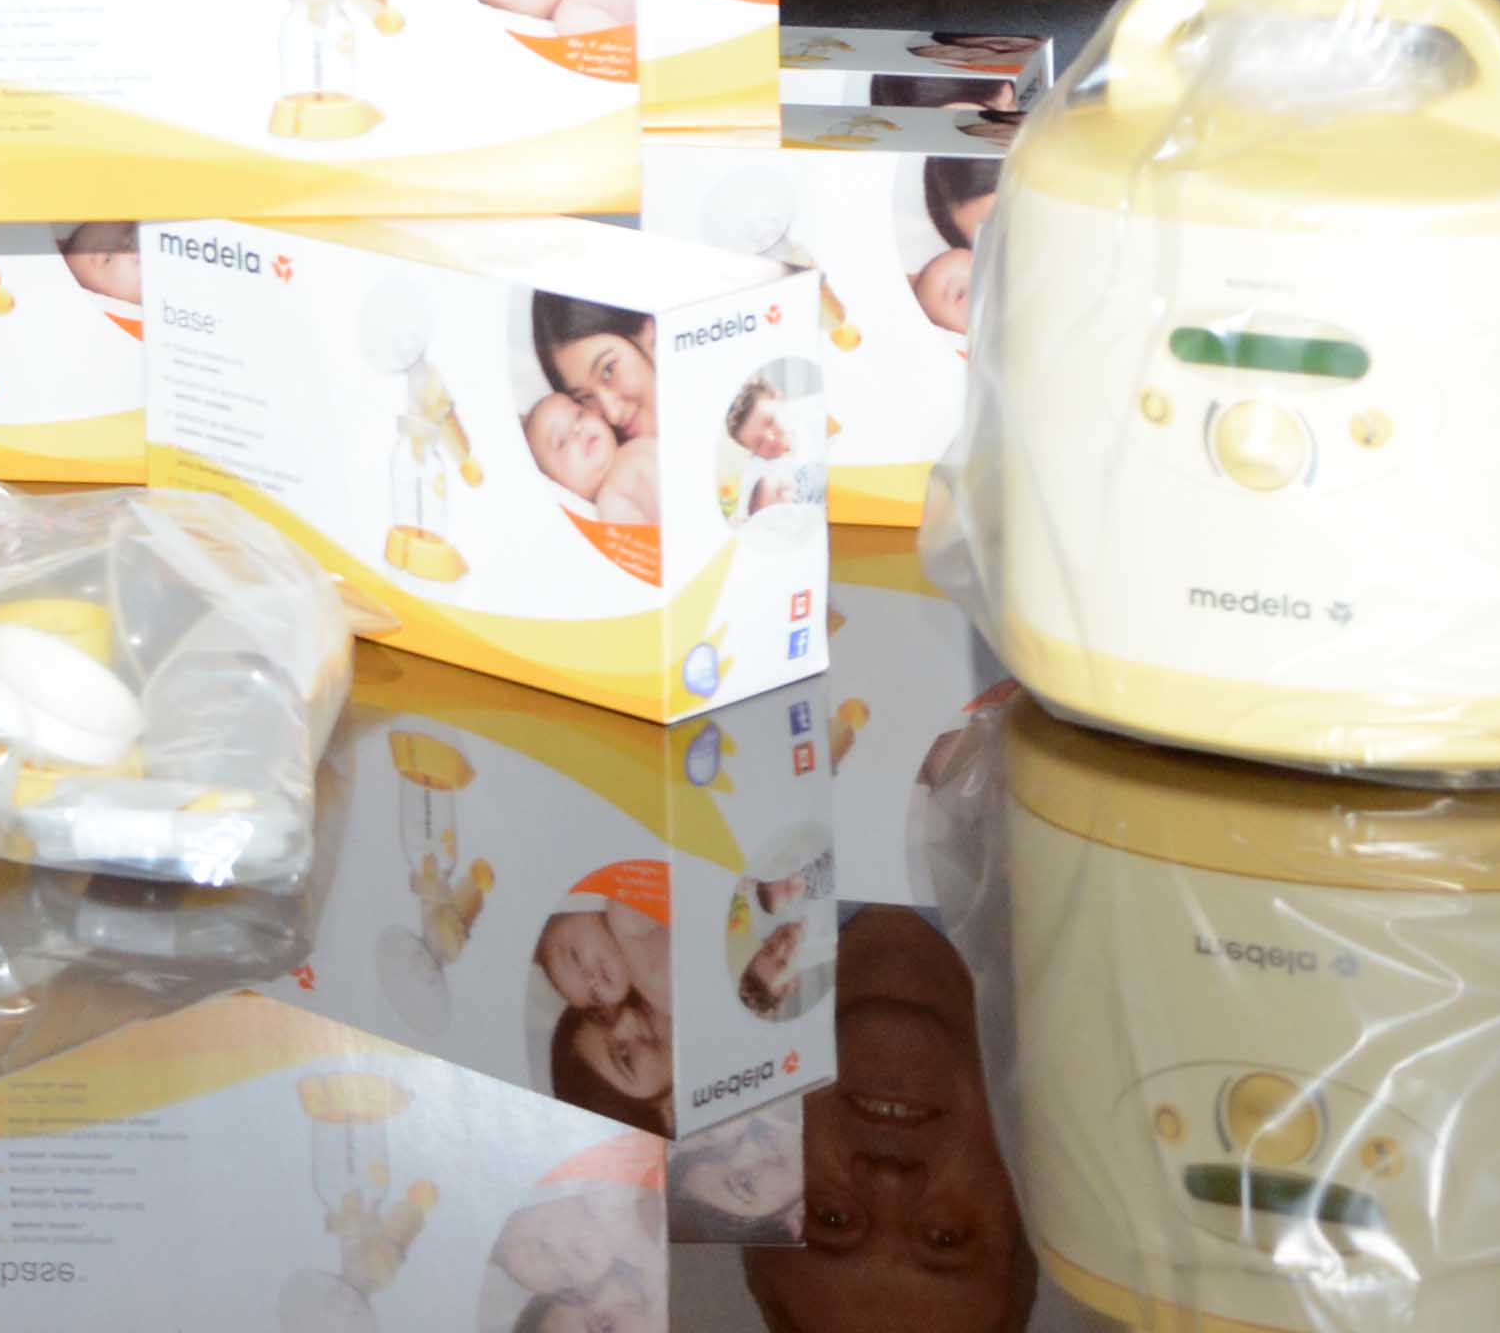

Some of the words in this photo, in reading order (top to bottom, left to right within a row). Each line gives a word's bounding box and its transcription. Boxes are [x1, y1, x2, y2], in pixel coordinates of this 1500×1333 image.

[158, 231, 263, 275] medela
[161, 297, 217, 335] base
[673, 310, 757, 352] medela
[1187, 586, 1312, 621] medela
